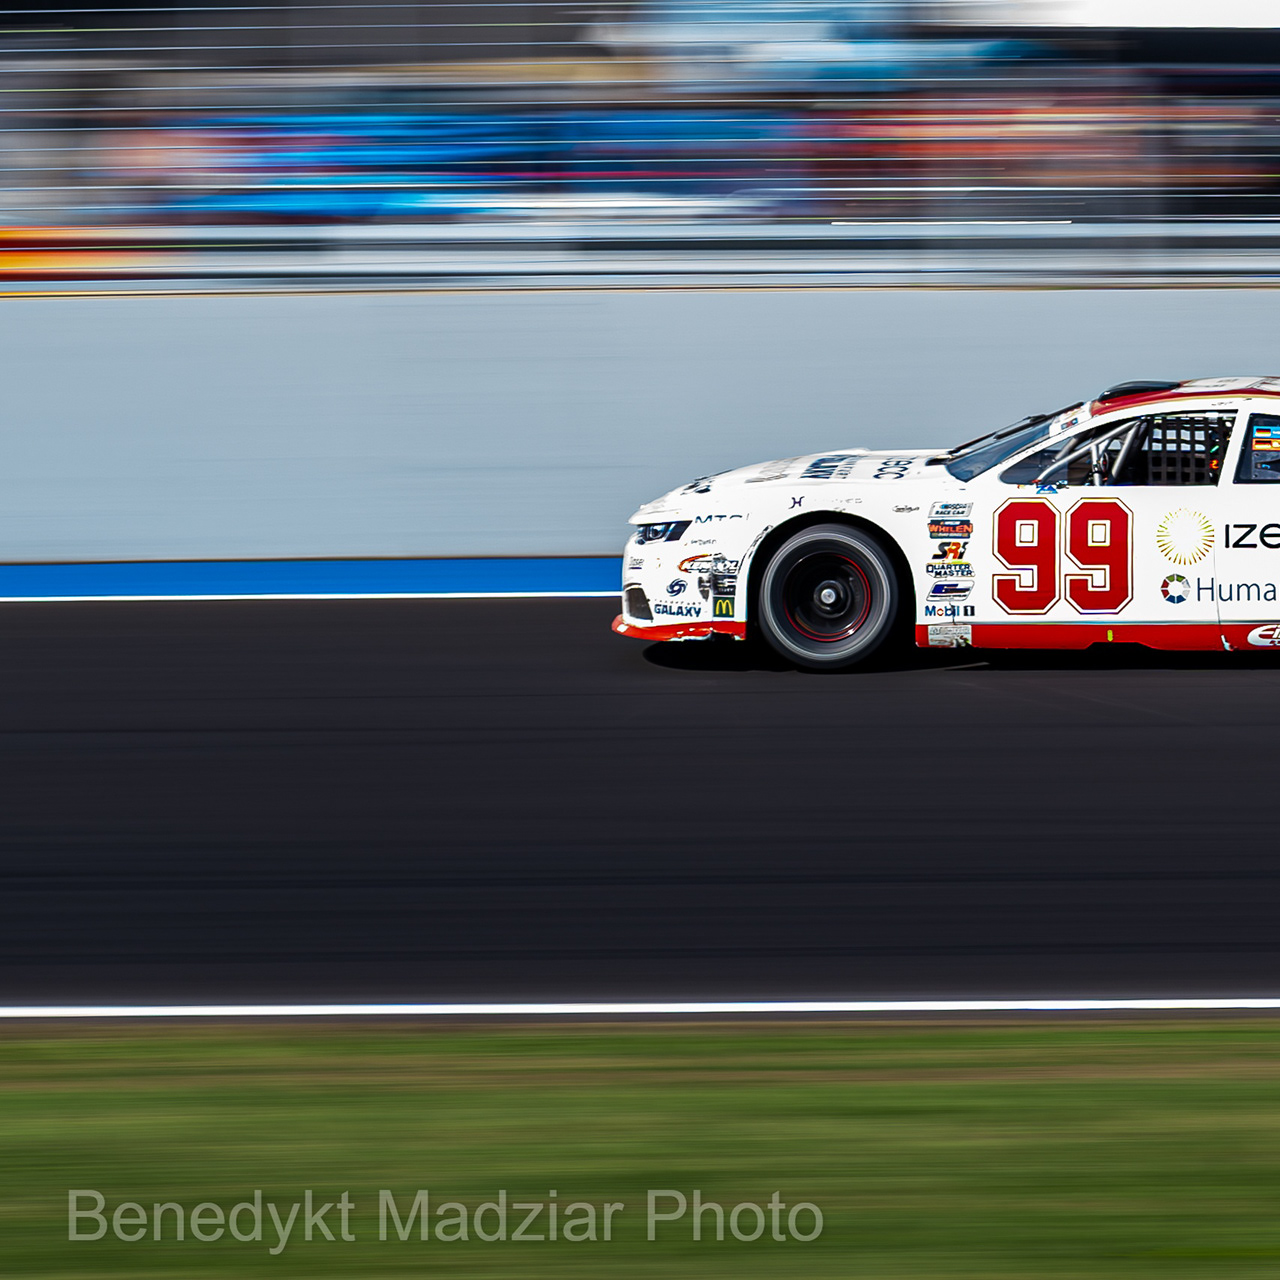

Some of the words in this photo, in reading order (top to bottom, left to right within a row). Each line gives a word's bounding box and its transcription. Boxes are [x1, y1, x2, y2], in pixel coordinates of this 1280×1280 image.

[992, 497, 1134, 615] 99
[654, 604, 701, 617] GALAXY
[925, 605, 960, 616] Mobil
